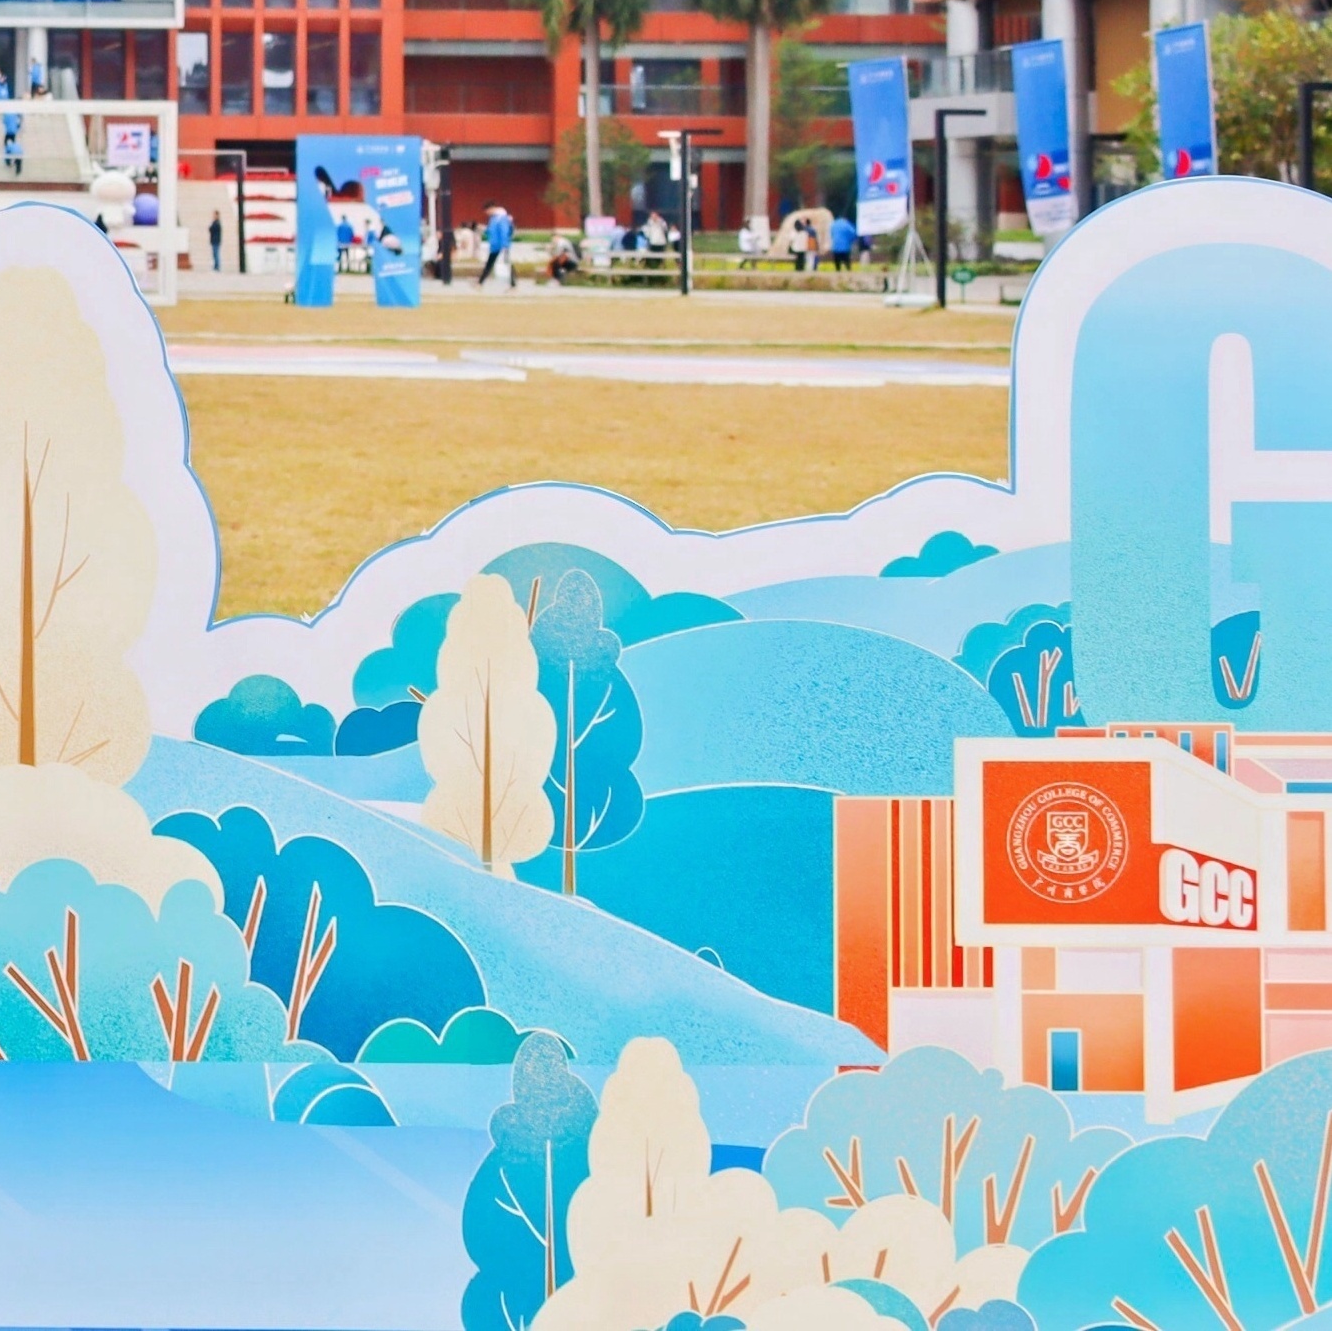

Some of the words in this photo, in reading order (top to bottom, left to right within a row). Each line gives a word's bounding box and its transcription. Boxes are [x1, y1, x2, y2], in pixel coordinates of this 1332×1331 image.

[1037, 788, 1087, 804] COLLEGE
[1088, 795, 1104, 807] OF
[1052, 816, 1083, 828] GCC
[1159, 848, 1254, 928] GCC
